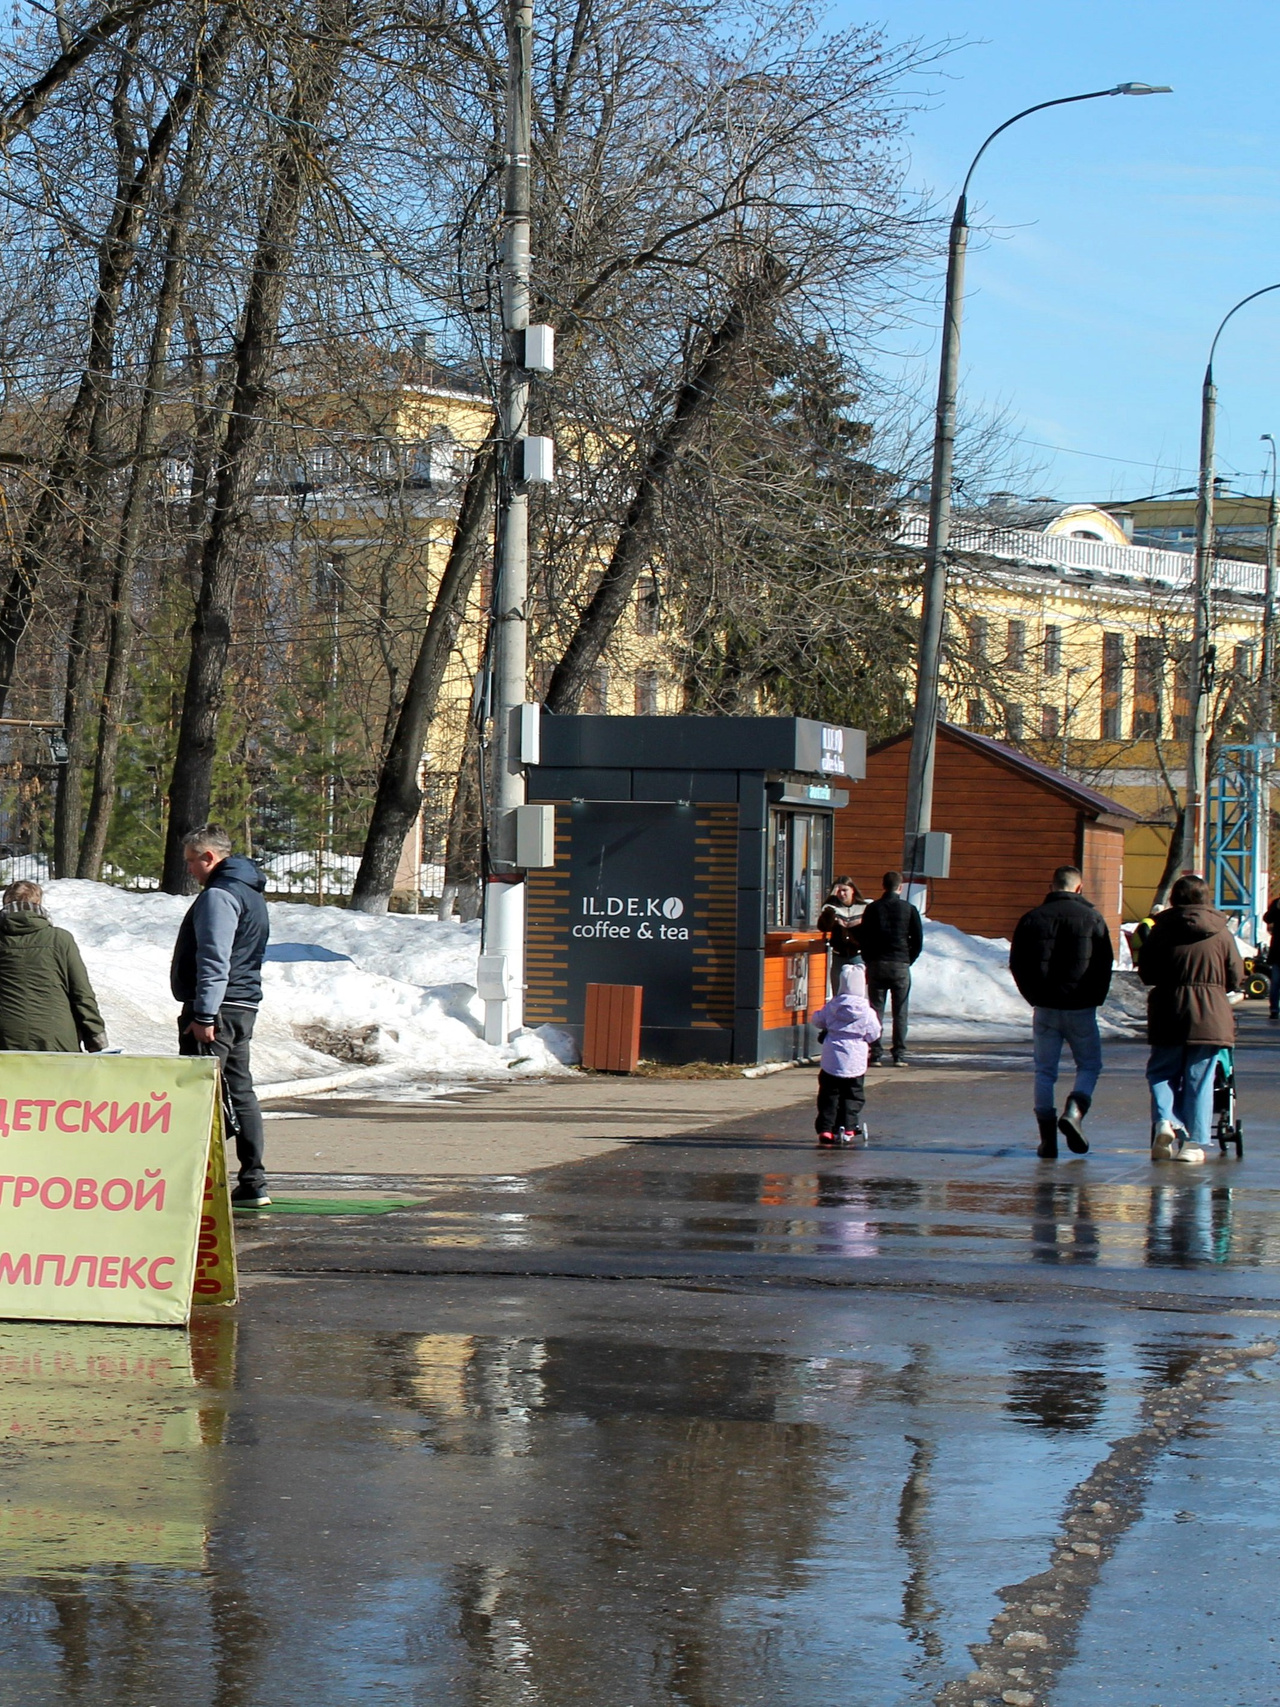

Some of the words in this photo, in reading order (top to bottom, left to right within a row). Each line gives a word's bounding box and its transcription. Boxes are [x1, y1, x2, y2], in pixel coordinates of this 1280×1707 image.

[572, 920, 631, 939] coffee
[637, 922, 654, 940] &
[660, 924, 689, 940] tea
